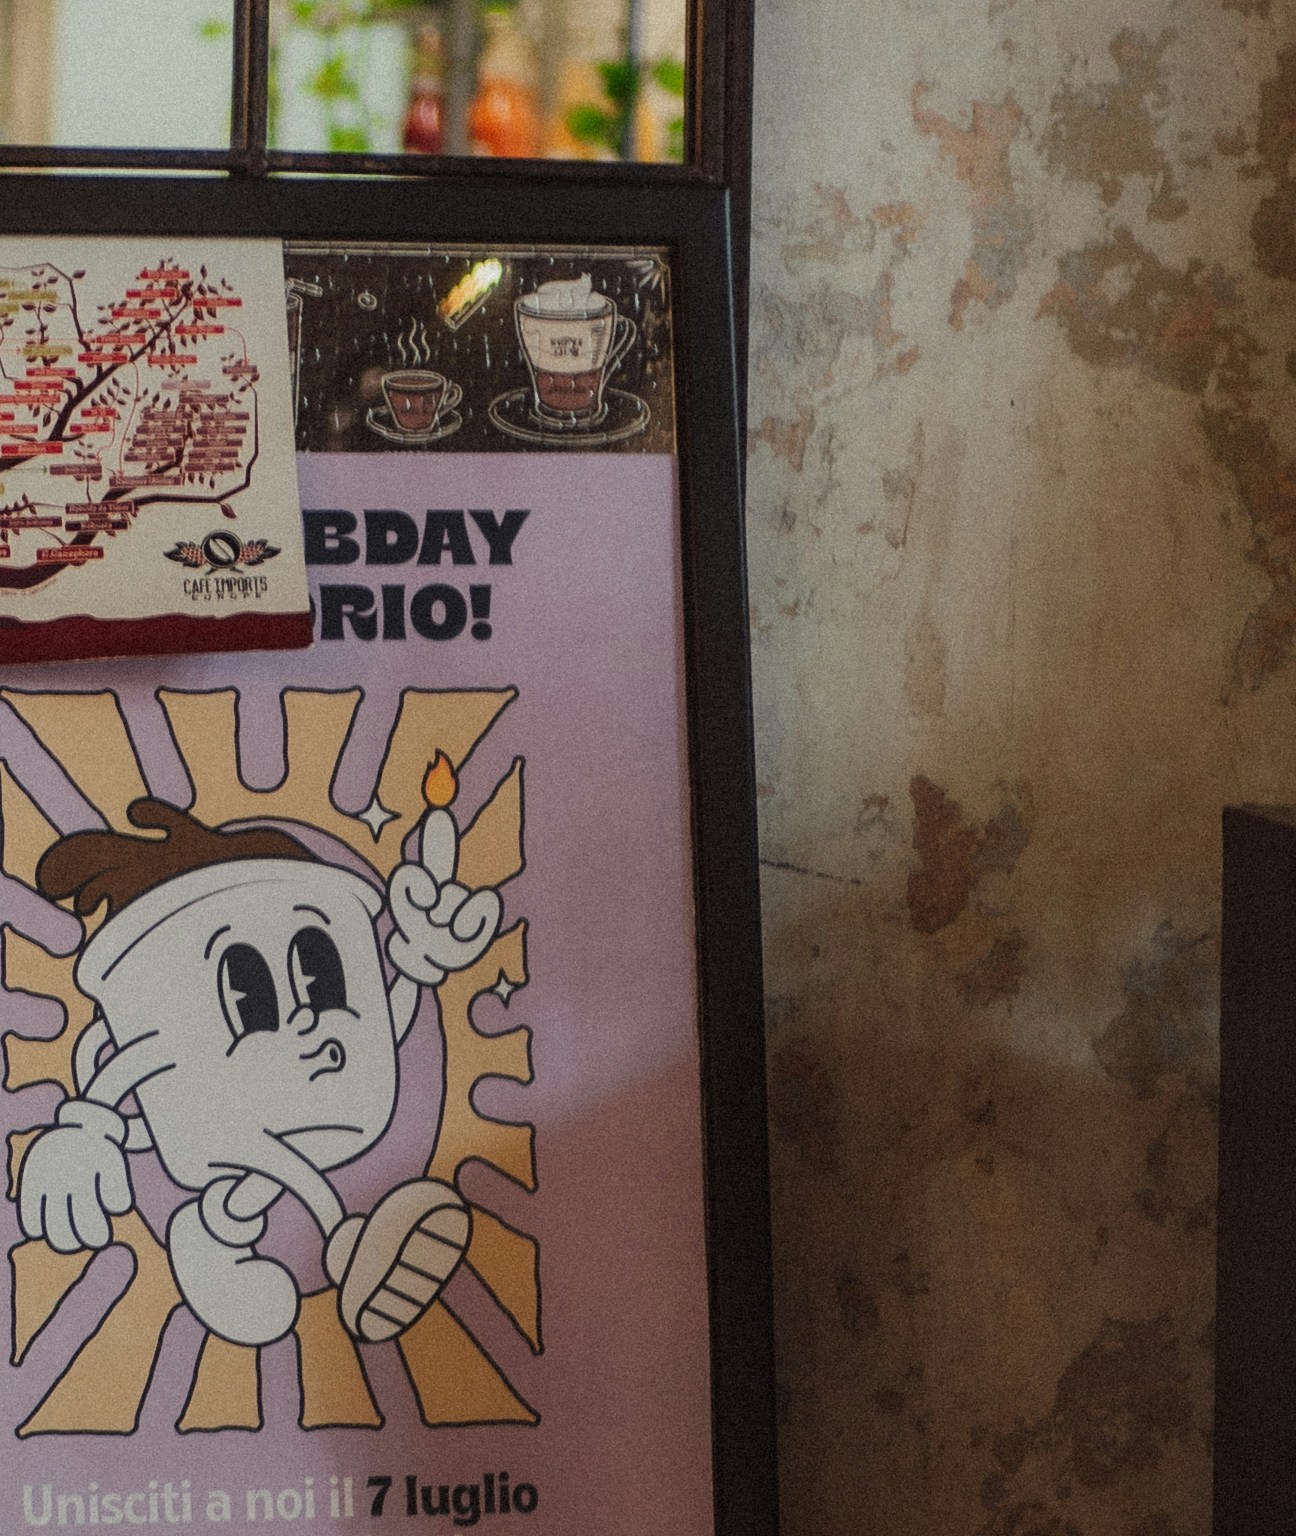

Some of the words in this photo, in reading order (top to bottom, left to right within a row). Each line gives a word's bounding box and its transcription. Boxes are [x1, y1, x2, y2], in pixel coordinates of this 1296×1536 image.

[302, 508, 531, 566] BDAY
[309, 583, 493, 641] RIO!
[21, 1479, 194, 1526] Unisciti
[206, 1490, 232, 1522] a
[246, 1478, 317, 1522] noi
[330, 1475, 354, 1519] il
[366, 1475, 394, 1519] 7
[404, 1472, 540, 1527] luglio
